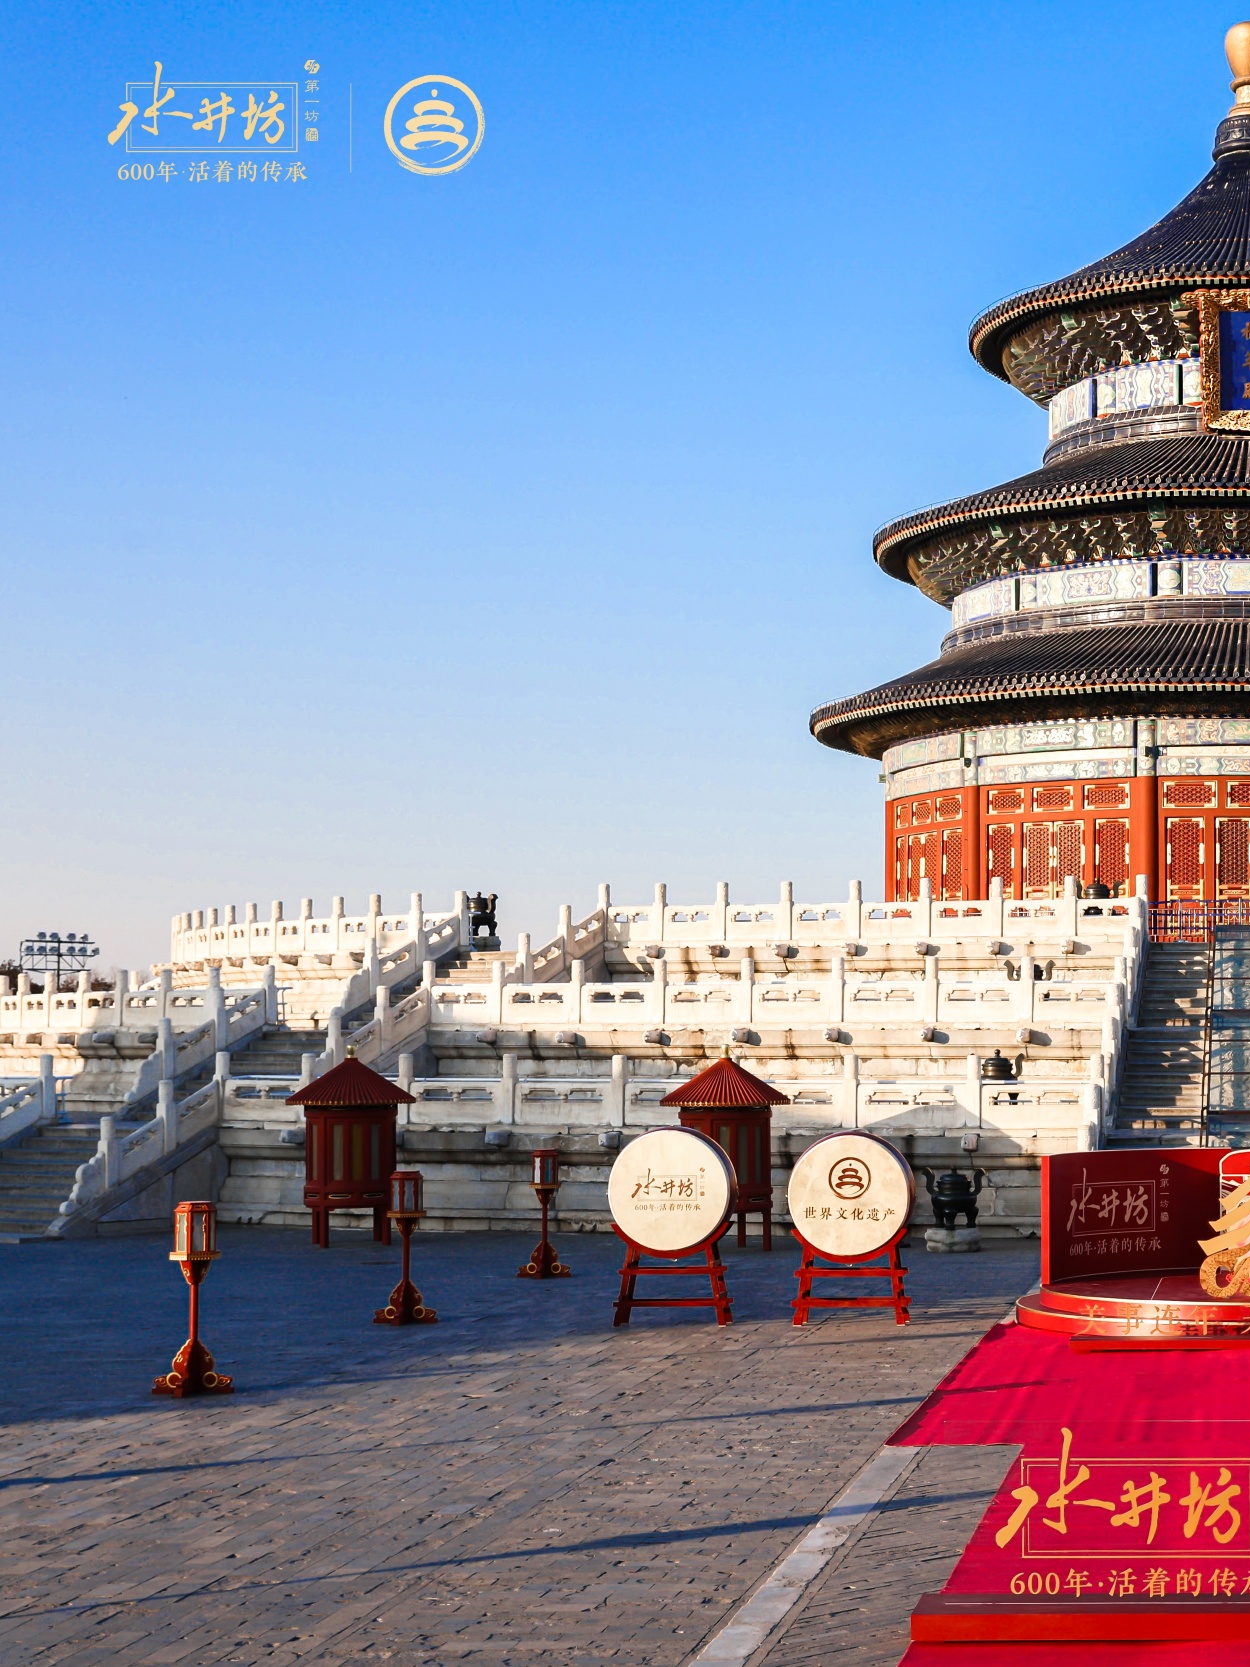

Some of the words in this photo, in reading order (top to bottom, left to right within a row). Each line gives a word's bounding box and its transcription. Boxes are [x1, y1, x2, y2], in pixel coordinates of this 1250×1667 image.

[631, 1167, 694, 1199] 水井坊
[1066, 1167, 1149, 1232] 水井坊
[803, 1206, 895, 1221] 世界文化遗产
[1074, 1303, 1220, 1336] 美事连年
[995, 1427, 1241, 1549] 水井坊
